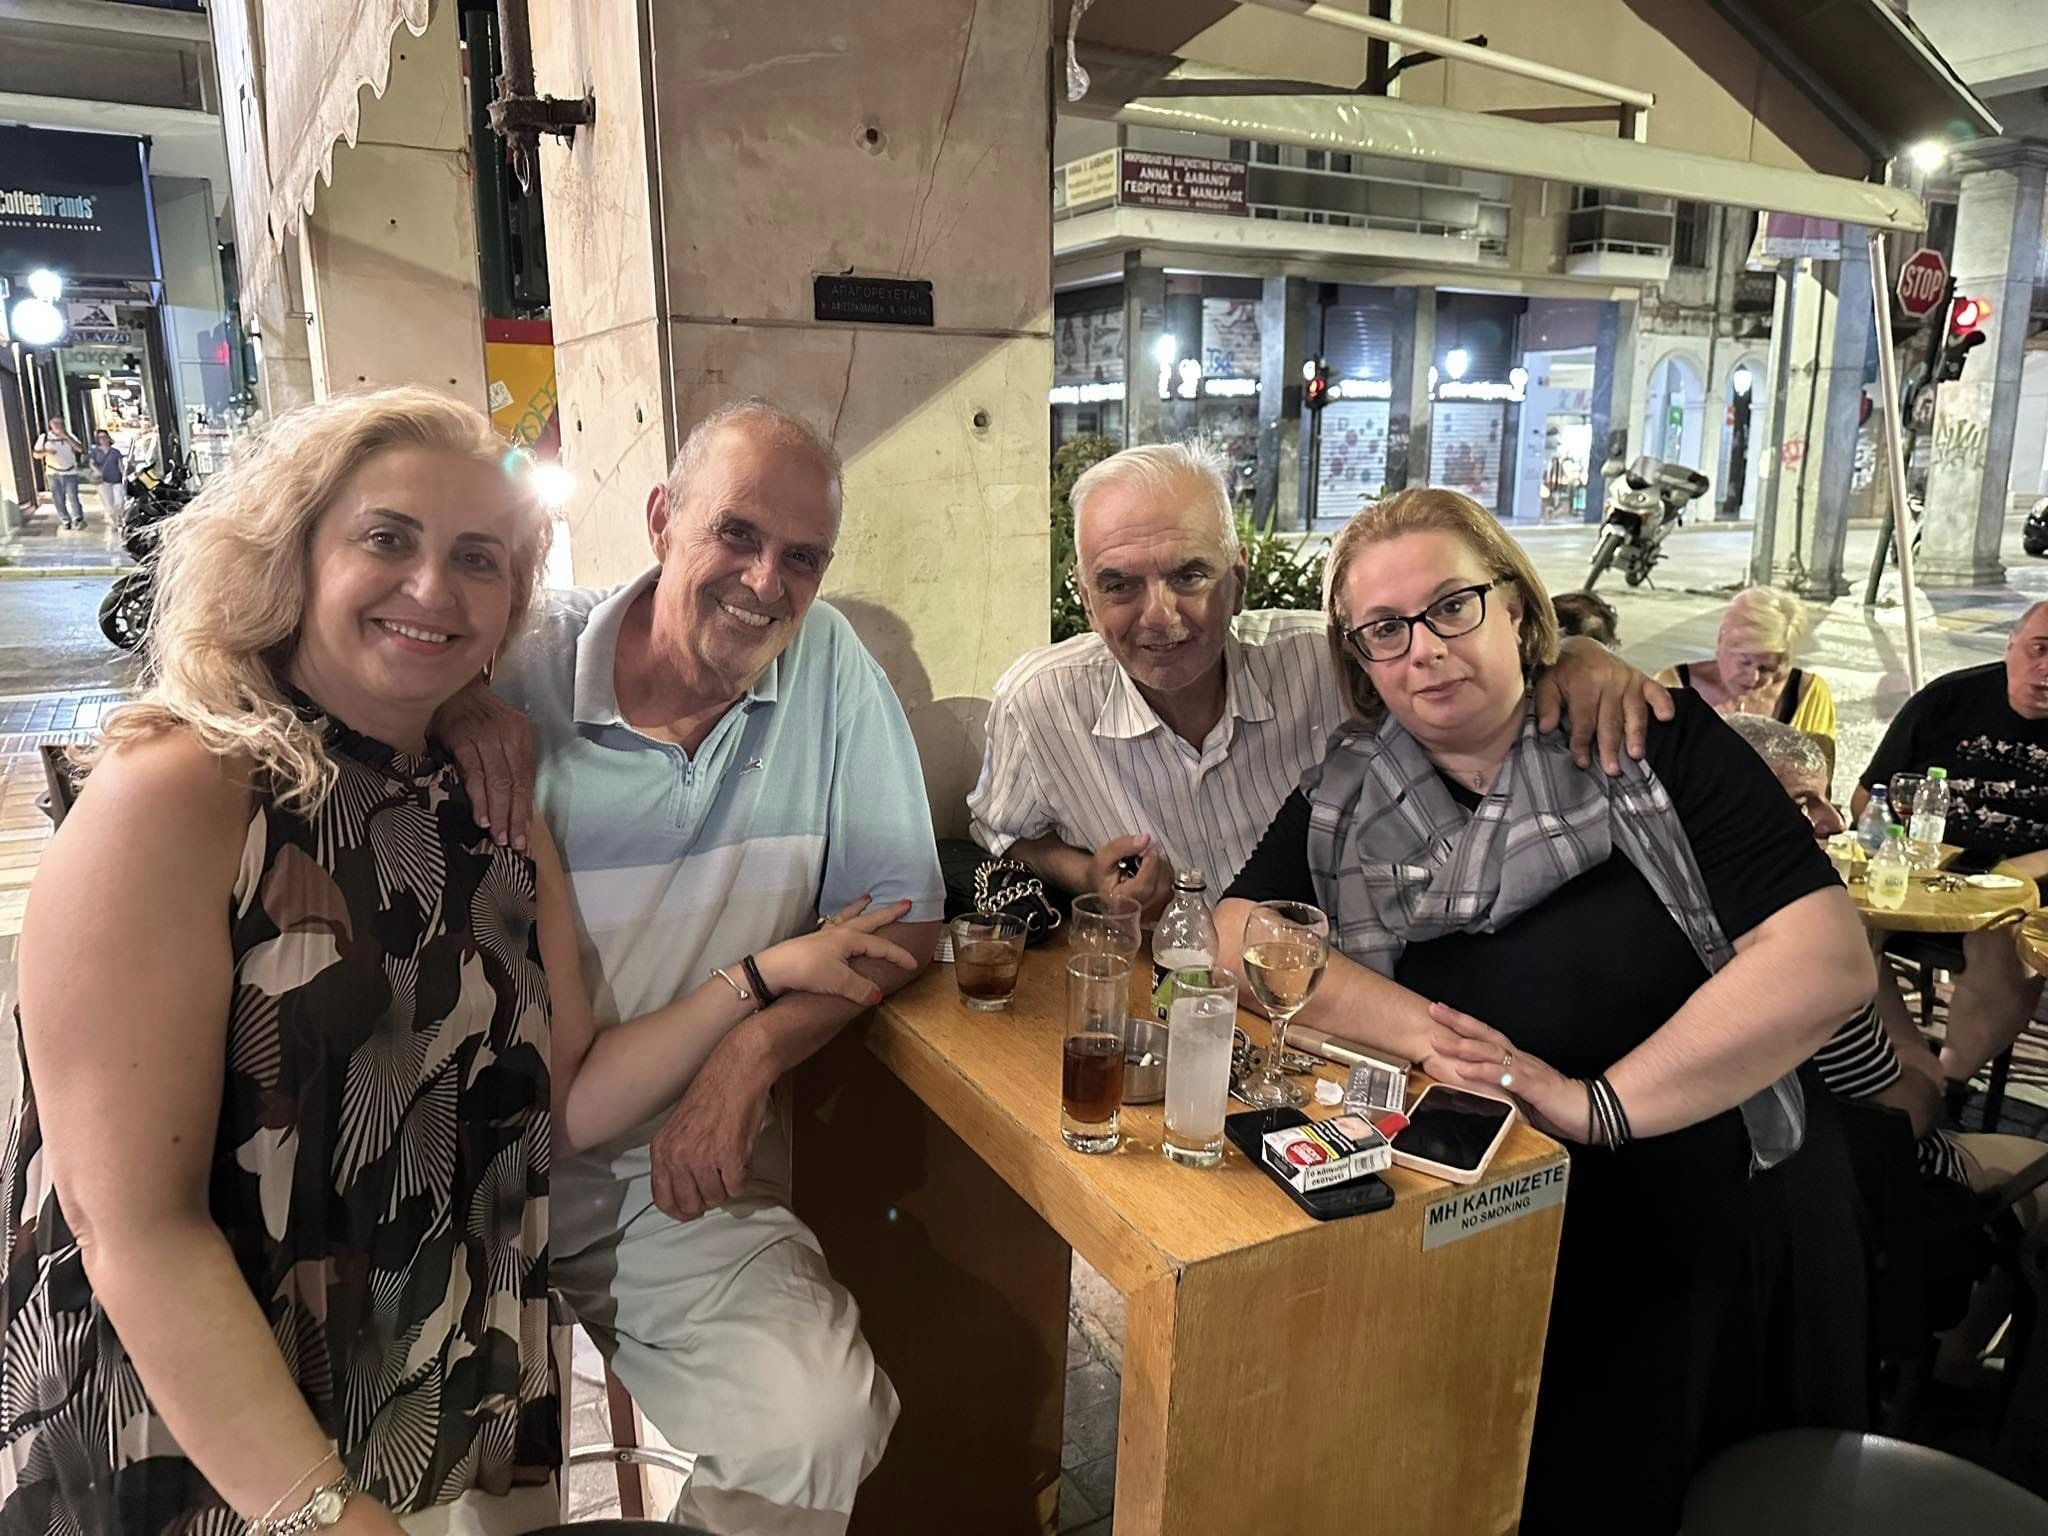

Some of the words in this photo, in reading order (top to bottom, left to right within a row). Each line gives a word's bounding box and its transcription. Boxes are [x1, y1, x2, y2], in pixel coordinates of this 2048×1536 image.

[1139, 167, 1170, 181] ΑΝΝΑ
[1184, 171, 1231, 187] ΔΑΒΑΝΟΥ
[1124, 180, 1173, 197] ΓΕΩΡΓΙΟΣ
[1190, 187, 1243, 202] ΜΑΝΔΑΛΟΣ
[36, 222, 102, 232] SPECIALISTS
[832, 284, 920, 301] ΑΠΑΓΟΡΕΥΕΤΑΙ
[1902, 264, 1943, 302] STOP
[1429, 1201, 1457, 1225] ΜΗ
[1463, 1165, 1565, 1214] ΚΑΠΝΙΖΕΤΕ
[1461, 1216, 1478, 1230] NO
[1479, 1197, 1531, 1223] SMOKING
